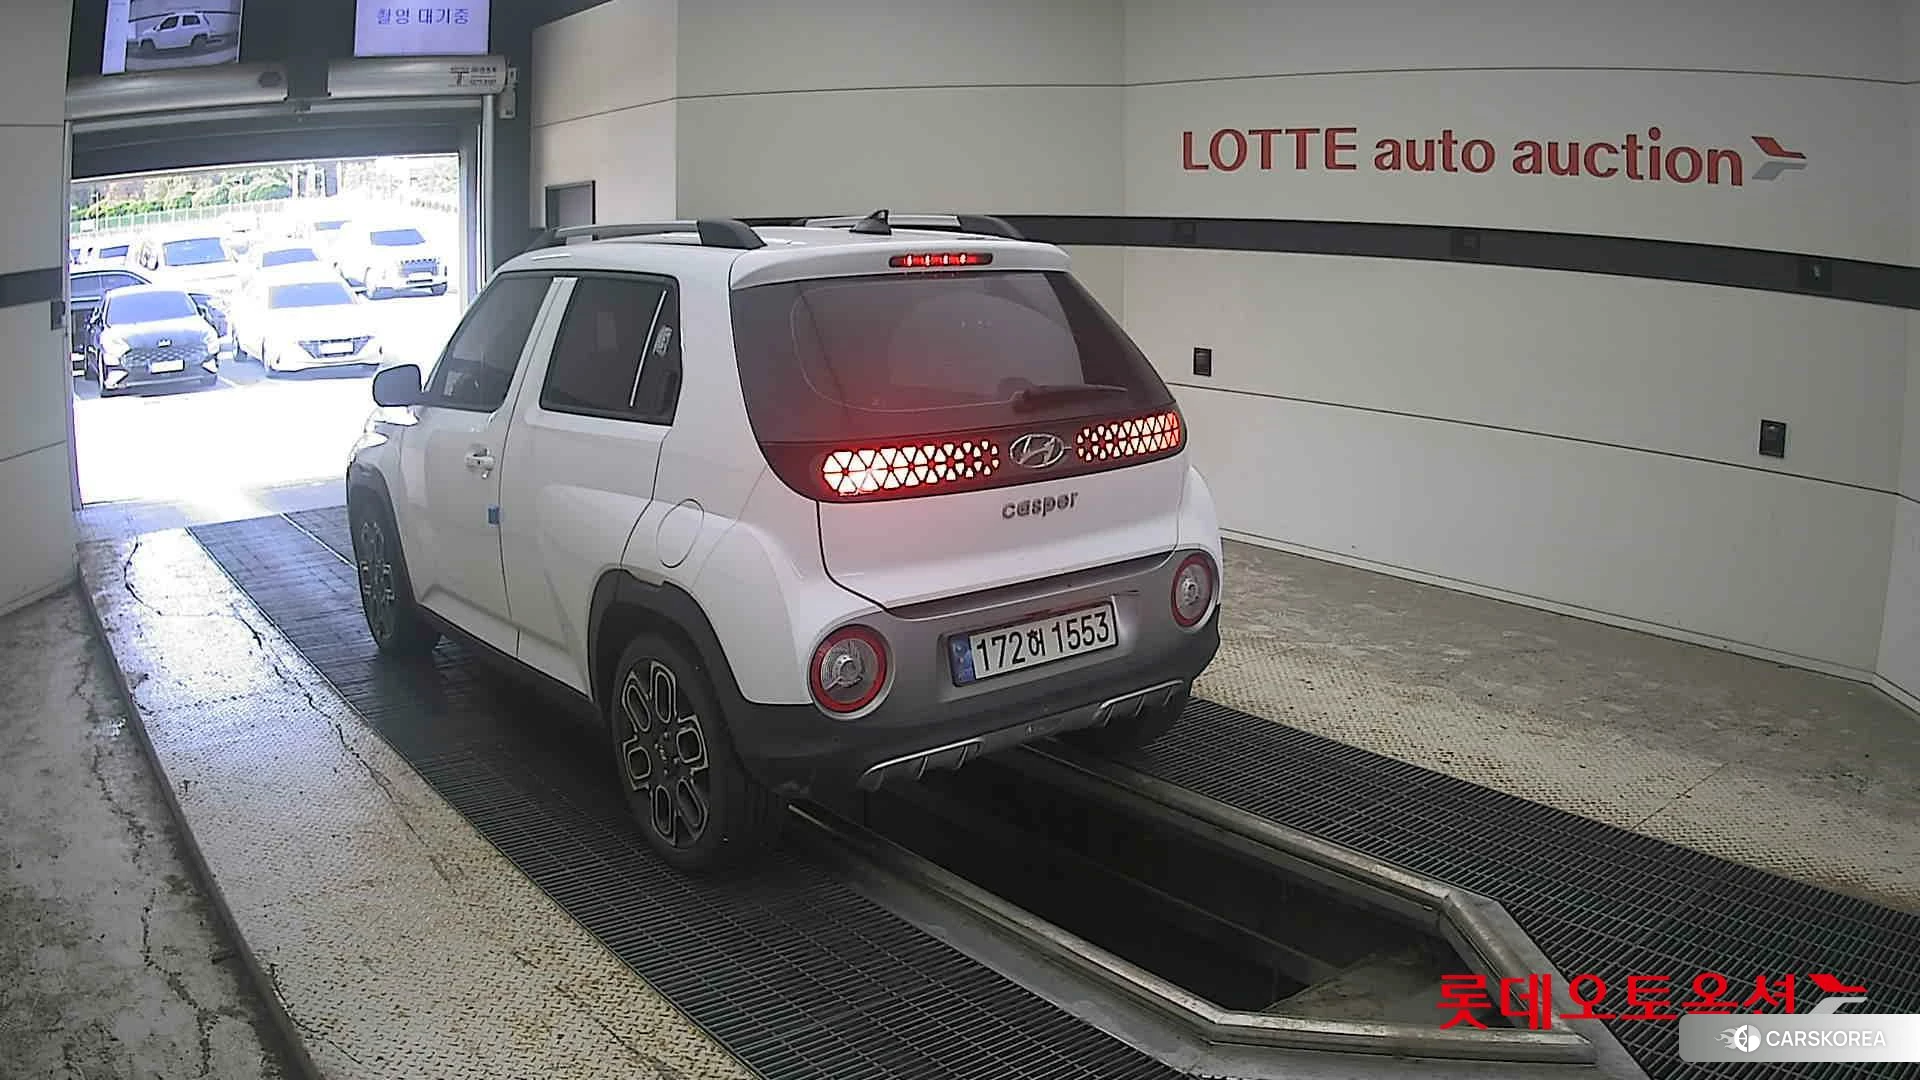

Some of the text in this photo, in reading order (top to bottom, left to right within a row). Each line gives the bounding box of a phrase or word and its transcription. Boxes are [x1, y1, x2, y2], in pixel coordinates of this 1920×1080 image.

[418, 8, 469, 25] 대기중
[1182, 126, 1744, 187] LOTTE auto auction
[1002, 491, 1079, 519] casper
[976, 611, 1110, 672] 172허 1553
